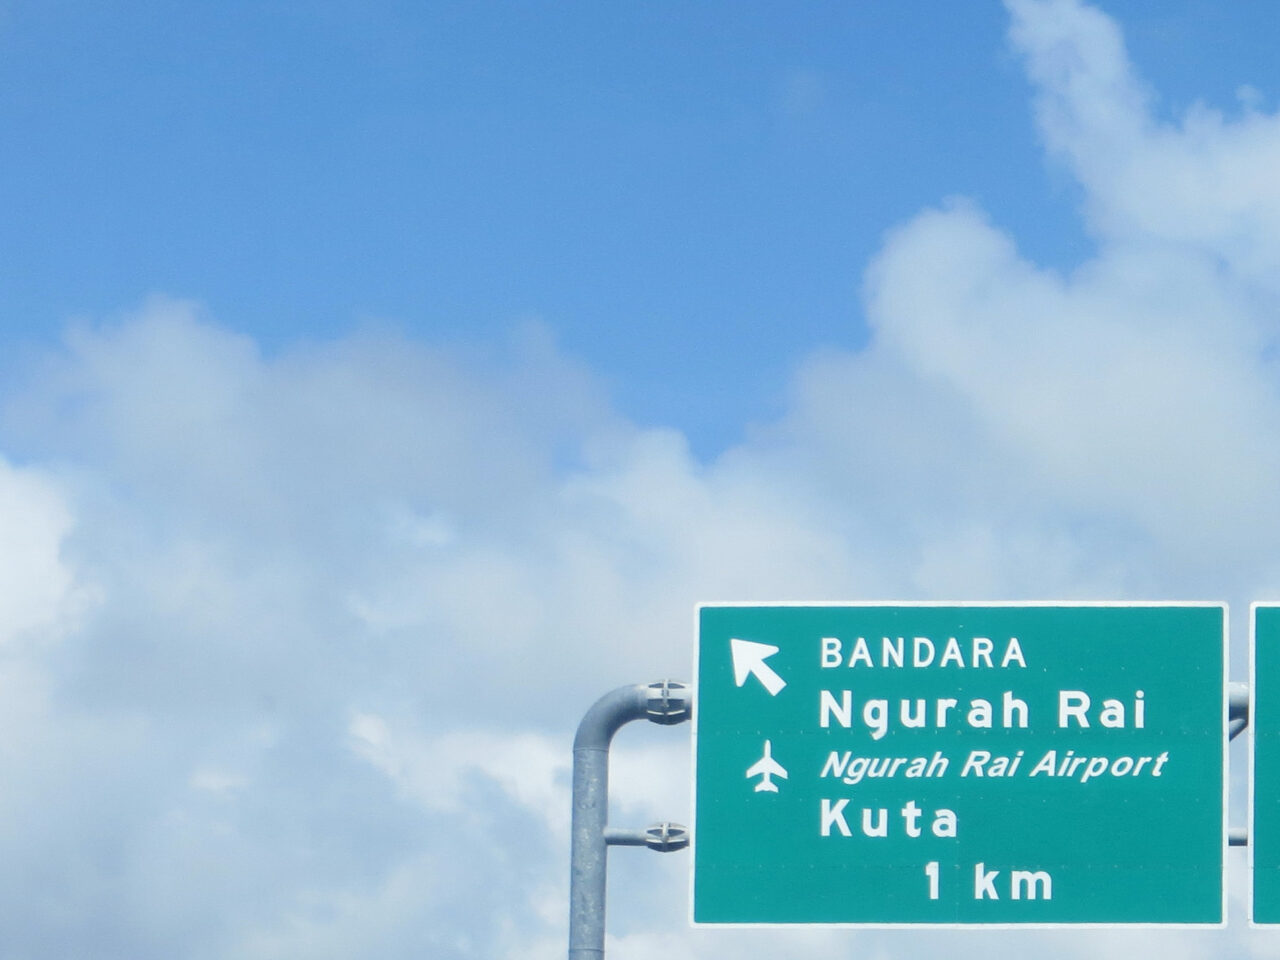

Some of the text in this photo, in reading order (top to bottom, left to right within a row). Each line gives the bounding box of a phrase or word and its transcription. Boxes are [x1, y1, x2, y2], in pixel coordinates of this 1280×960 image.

[820, 637, 1027, 668] BANDARA
[819, 689, 1145, 740] Ngurah Rai
[820, 750, 1169, 785] Ngurah Rai Airport
[820, 798, 957, 838] Kuta
[925, 861, 1052, 900] 1 km
